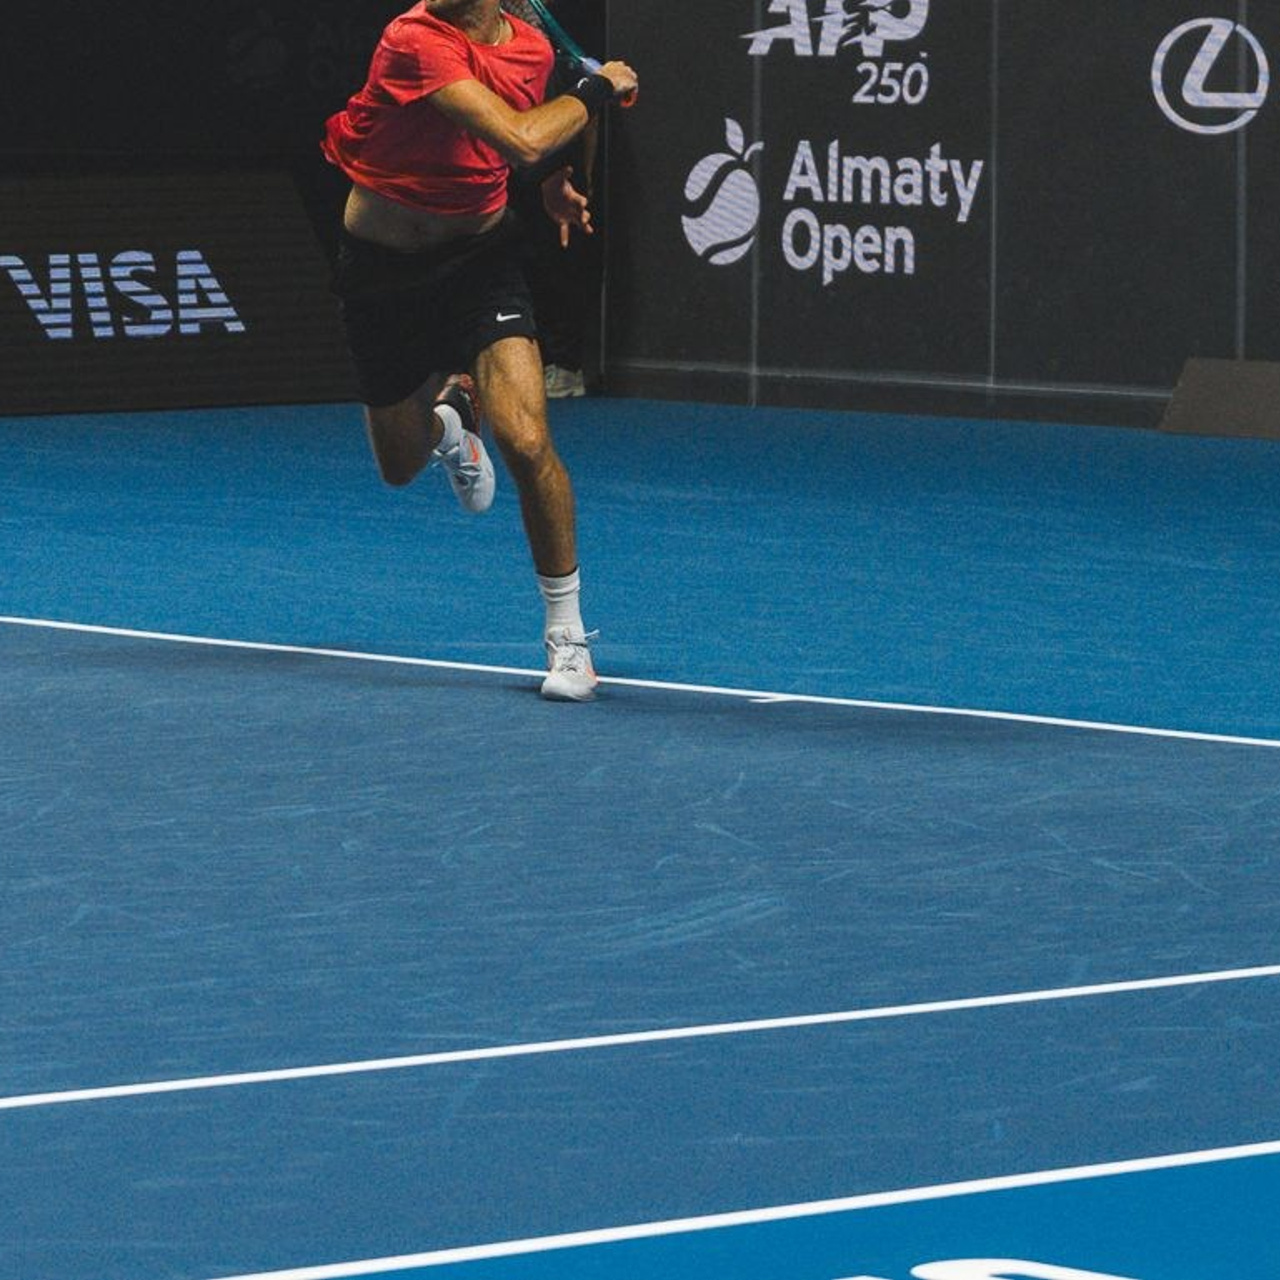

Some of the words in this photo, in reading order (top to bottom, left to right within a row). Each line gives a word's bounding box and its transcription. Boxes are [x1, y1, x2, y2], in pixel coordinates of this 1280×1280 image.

[852, 61, 929, 105] 250
[782, 139, 984, 225] Almaty
[781, 207, 915, 286] Open
